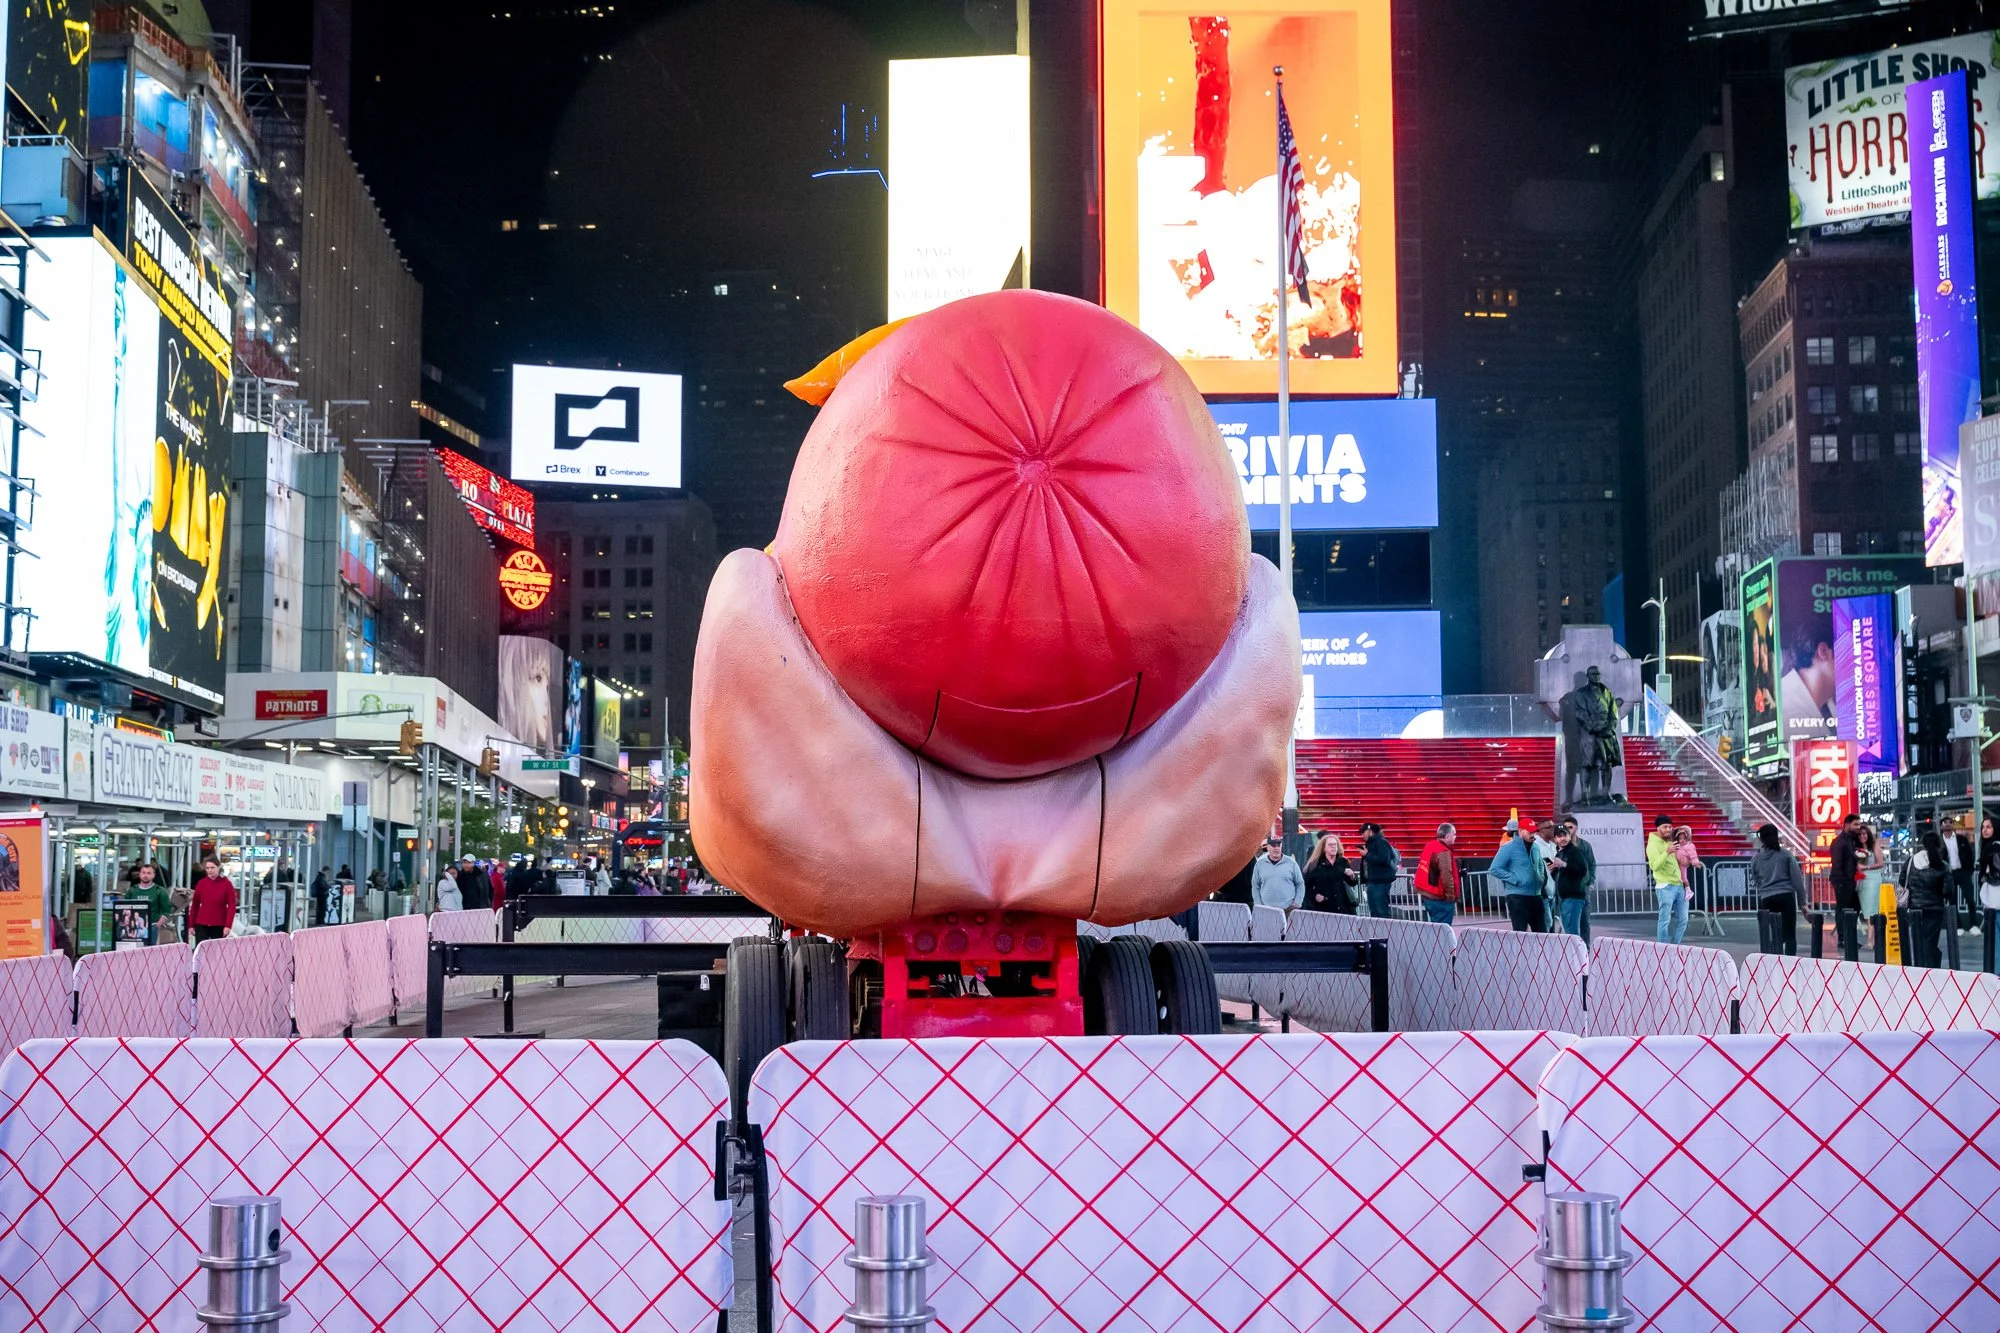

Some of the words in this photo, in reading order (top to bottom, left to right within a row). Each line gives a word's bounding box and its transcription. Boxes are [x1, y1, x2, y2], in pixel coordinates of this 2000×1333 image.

[1808, 55, 1904, 119] LITTLE
[1882, 93, 1901, 105] OF
[1809, 98, 1985, 203] HORR
[1825, 204, 1864, 217] Westside
[1867, 199, 1899, 211] Theatre
[134, 196, 161, 260] BEST
[160, 229, 199, 307] MUSICAL
[1937, 234, 1945, 280] CAESARS
[134, 241, 163, 289] TONY
[162, 275, 196, 326] AWARD
[164, 400, 181, 428] THE
[1974, 419, 2000, 442] BROA
[1223, 434, 1366, 476] RIVIA
[560, 465, 581, 474] Brex
[610, 468, 650, 477] Combinator
[503, 501, 532, 529] PLAZA
[152, 436, 226, 629] OMMY
[157, 561, 167, 578] ON
[166, 566, 198, 594] BROADWAY
[1826, 567, 1863, 582] Pick
[1866, 569, 1898, 581] me.
[1812, 584, 1879, 598] Choose
[1814, 600, 1832, 613] St
[1331, 638, 1350, 651] OF
[1853, 618, 1861, 656] BETTER
[1862, 616, 1875, 683] SQUARE
[1326, 653, 1367, 666] RIDES
[1854, 666, 1862, 687] FOR
[66, 702, 94, 724] BLUE
[386, 703, 415, 711] OPEN
[1855, 687, 1865, 740] COALITION
[1865, 689, 1876, 739] TIMES
[11, 709, 29, 734] SHOP
[1789, 717, 1825, 728] EVERY
[274, 772, 321, 811] SWAROVSKI
[1810, 745, 1849, 823] tkts
[628, 837, 643, 845] CVS
